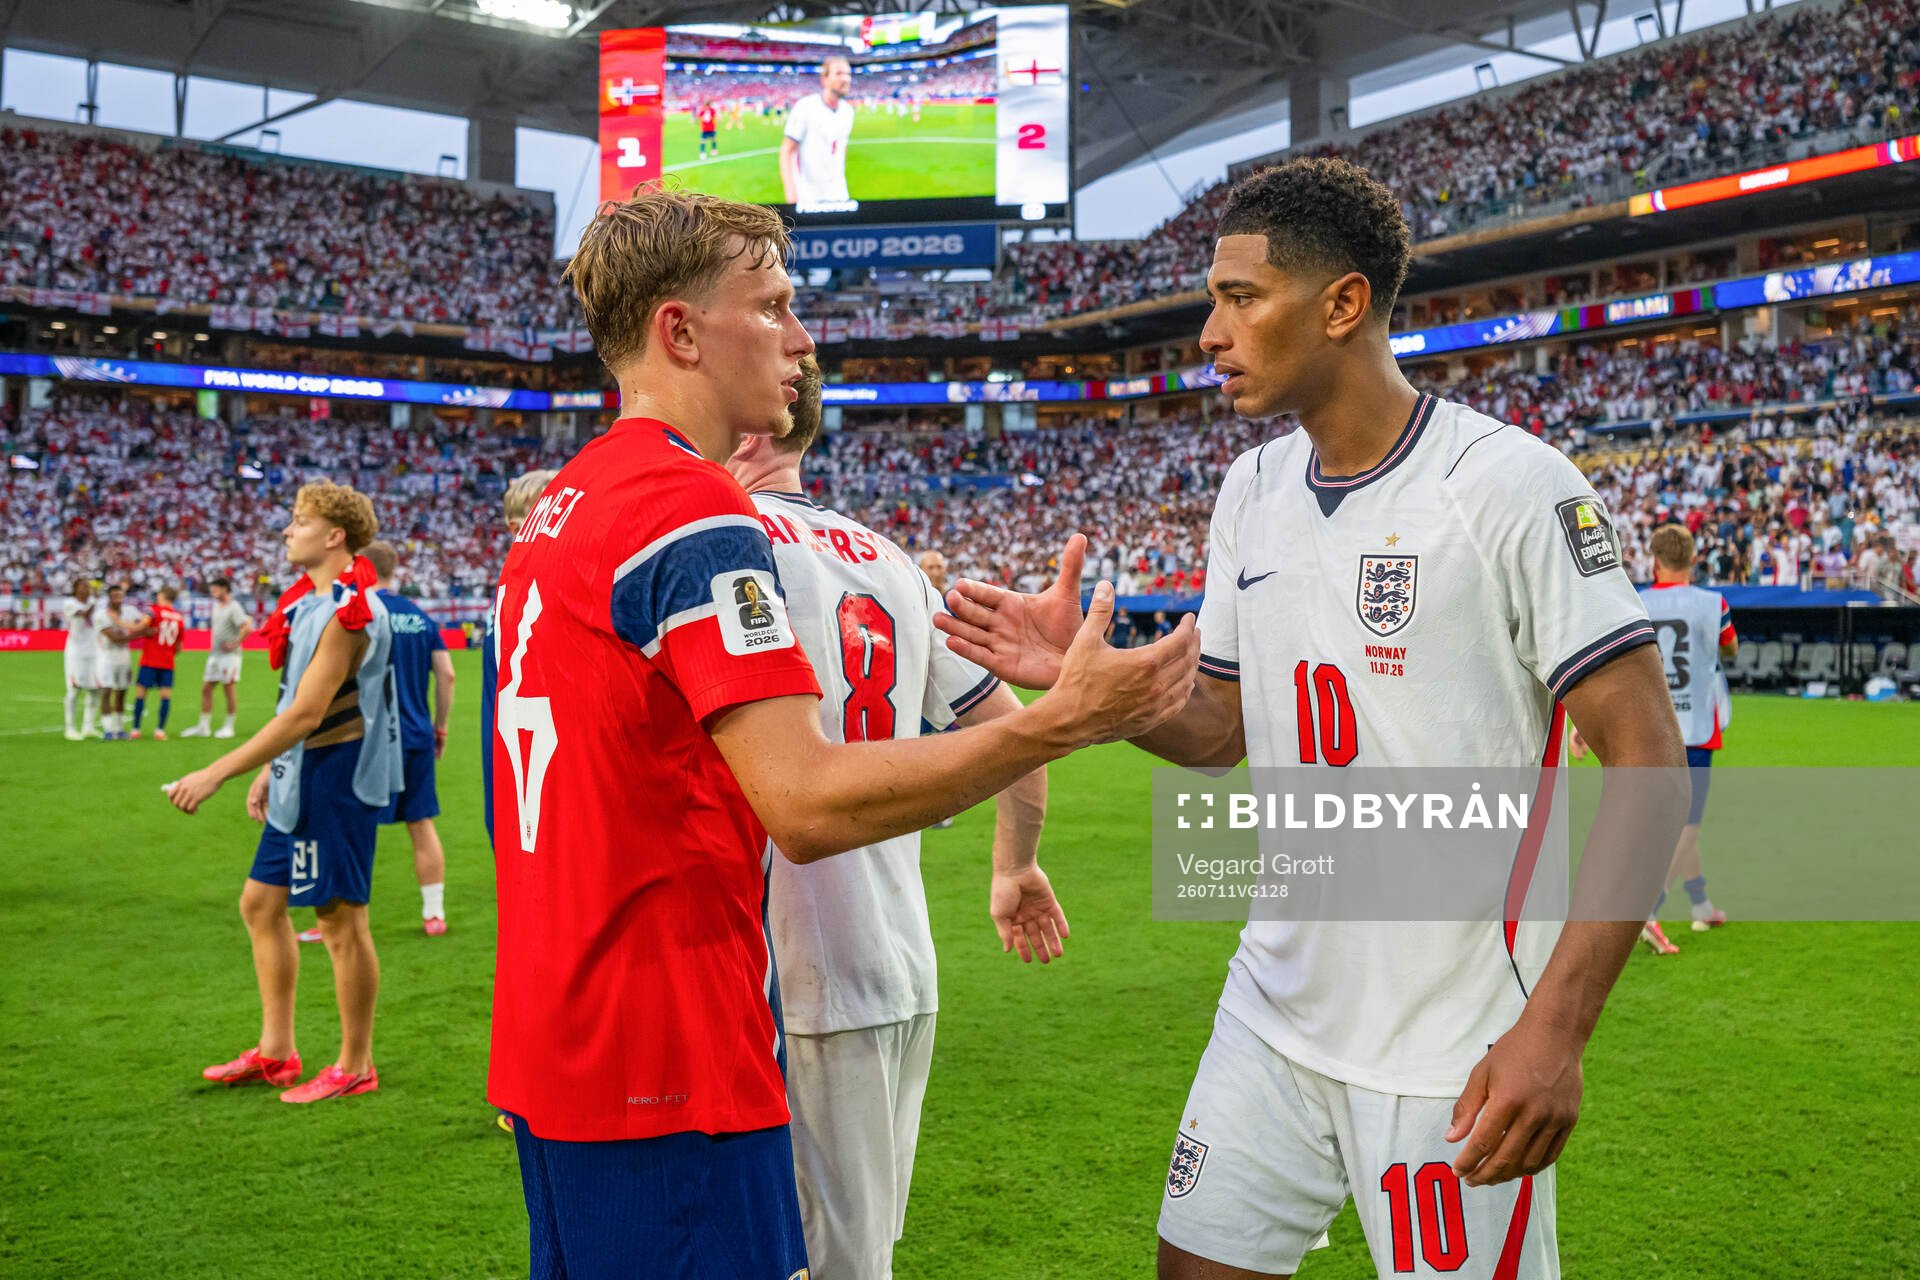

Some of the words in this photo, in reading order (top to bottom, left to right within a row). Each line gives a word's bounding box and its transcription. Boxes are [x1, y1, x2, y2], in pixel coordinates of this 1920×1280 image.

[1017, 124, 1047, 150] 2
[617, 137, 646, 168] 1
[831, 238, 879, 259] CUP
[881, 234, 965, 257] 2026
[1597, 552, 1616, 563] FIFA
[744, 631, 766, 639] WORLD
[767, 628, 778, 636] CUP
[751, 616, 768, 626] FIFA
[745, 634, 780, 647] 2026
[1365, 644, 1407, 661] NORWAY
[836, 591, 897, 743] 8
[1370, 661, 1404, 677] 11.07.26
[1294, 660, 1359, 767] 10
[292, 840, 319, 880] 21
[1380, 1161, 1469, 1274] 10
